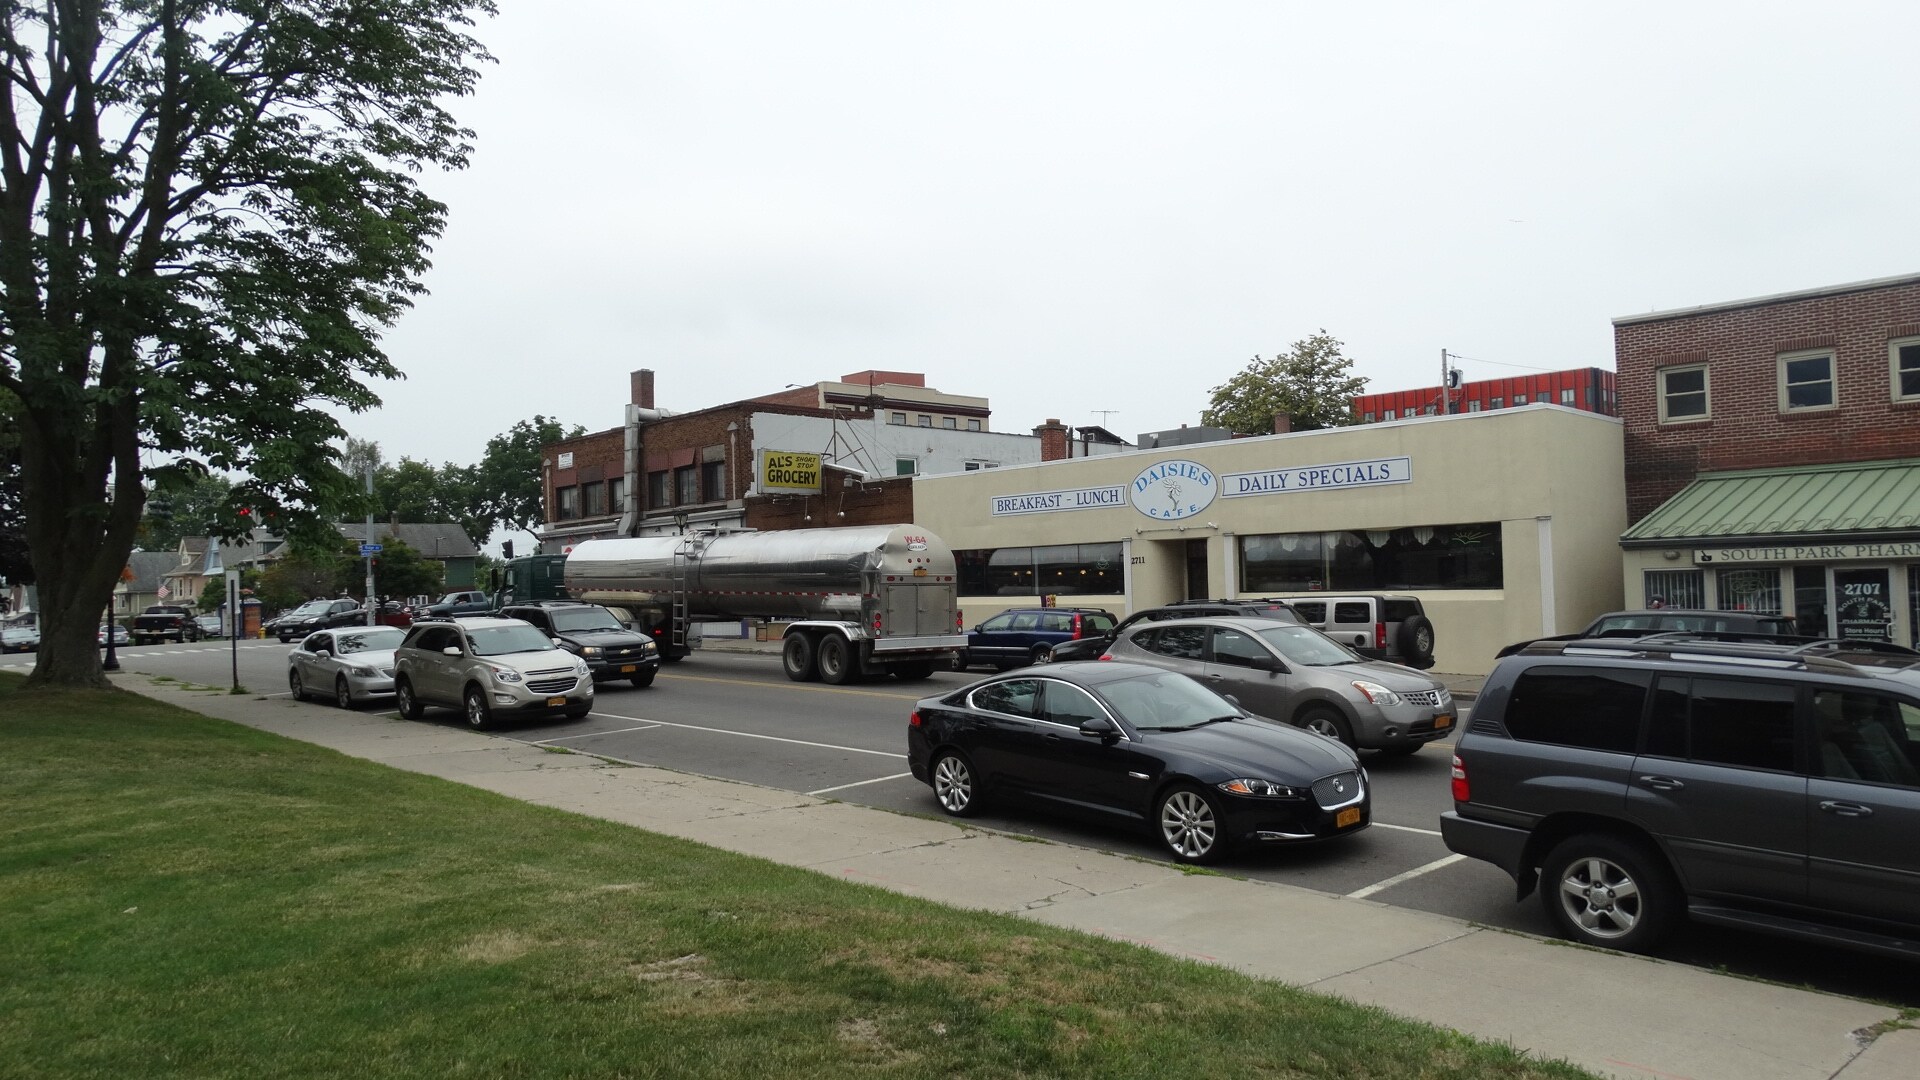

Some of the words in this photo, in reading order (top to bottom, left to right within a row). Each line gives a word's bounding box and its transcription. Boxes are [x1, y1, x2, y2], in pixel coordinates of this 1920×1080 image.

[768, 456, 793, 469] AL'S
[768, 469, 817, 484] GROCERY
[1135, 463, 1212, 493] DAISIES
[1239, 473, 1289, 492] DAILY
[1298, 463, 1390, 487] SPECIALS
[997, 494, 1062, 512] BREAKFAST
[1077, 489, 1119, 506] LUNCH
[1150, 504, 1197, 518] CAFE
[904, 536, 926, 544] W-64
[1131, 556, 1145, 565] 2711
[1720, 547, 1788, 561] SOUTH
[1793, 545, 1847, 559] PARK
[1844, 583, 1881, 595] 2707
[1838, 596, 1866, 612] SOUTH
[1866, 597, 1889, 612] PARK
